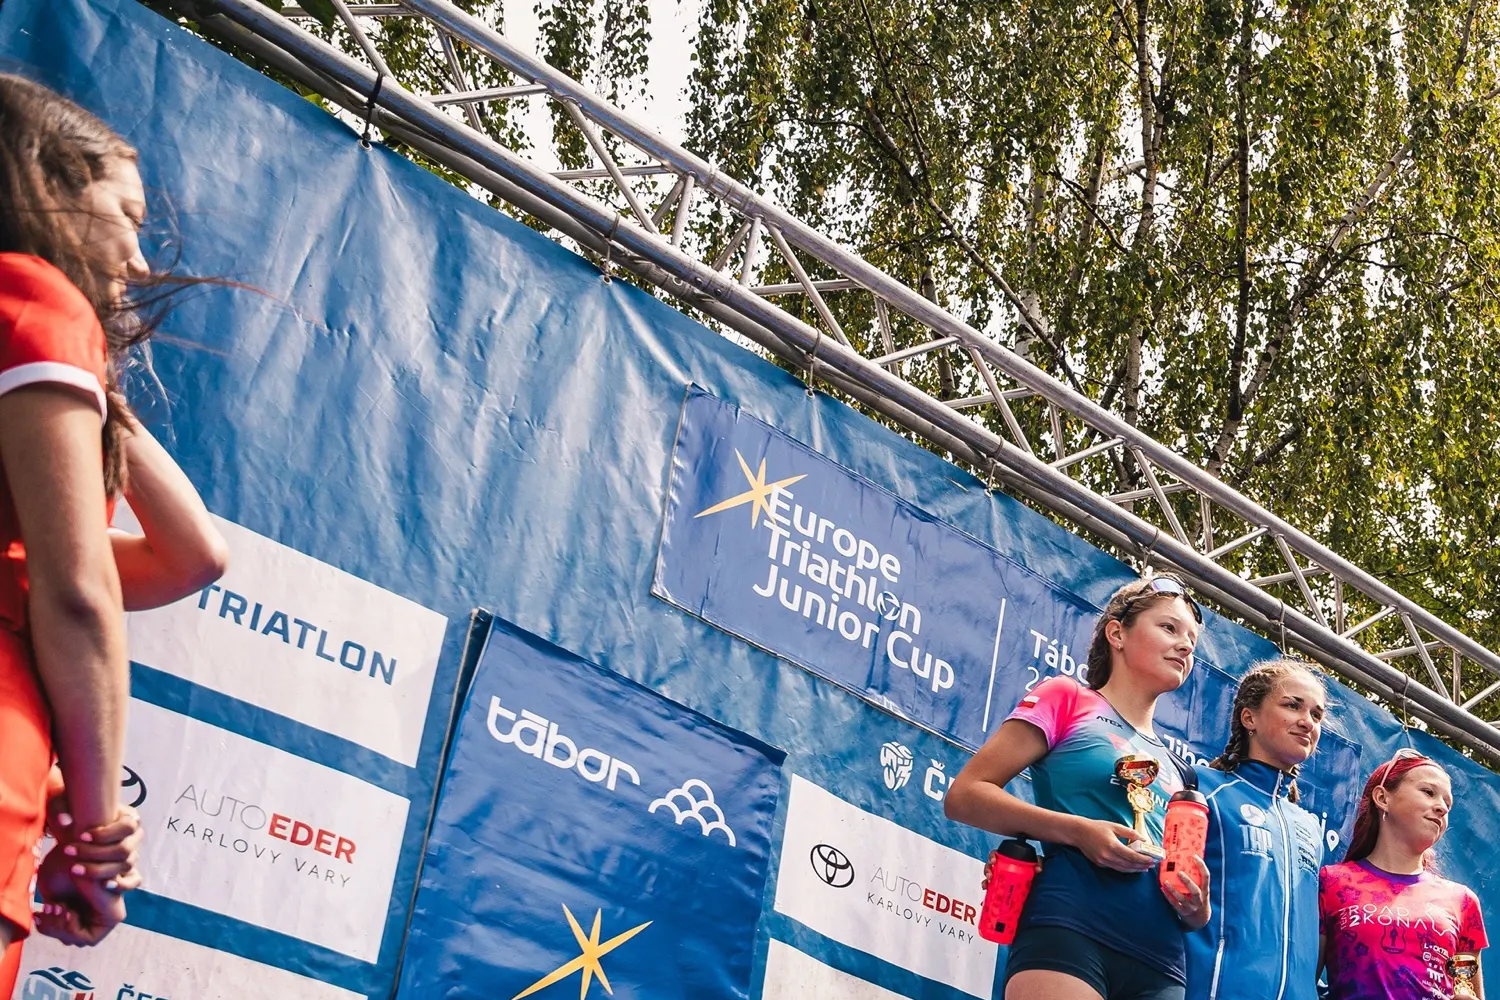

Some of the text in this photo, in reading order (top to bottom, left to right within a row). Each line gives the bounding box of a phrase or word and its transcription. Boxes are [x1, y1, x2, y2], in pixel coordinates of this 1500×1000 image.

[763, 519, 921, 635] Triathlon
[769, 483, 900, 583] Europe
[197, 584, 397, 686] TRIATLON
[752, 564, 955, 693] Junior Cup
[1030, 628, 1090, 685] Tábo
[167, 816, 351, 889] KARLOVY VARY
[867, 893, 974, 945] KARLOVY VARY
